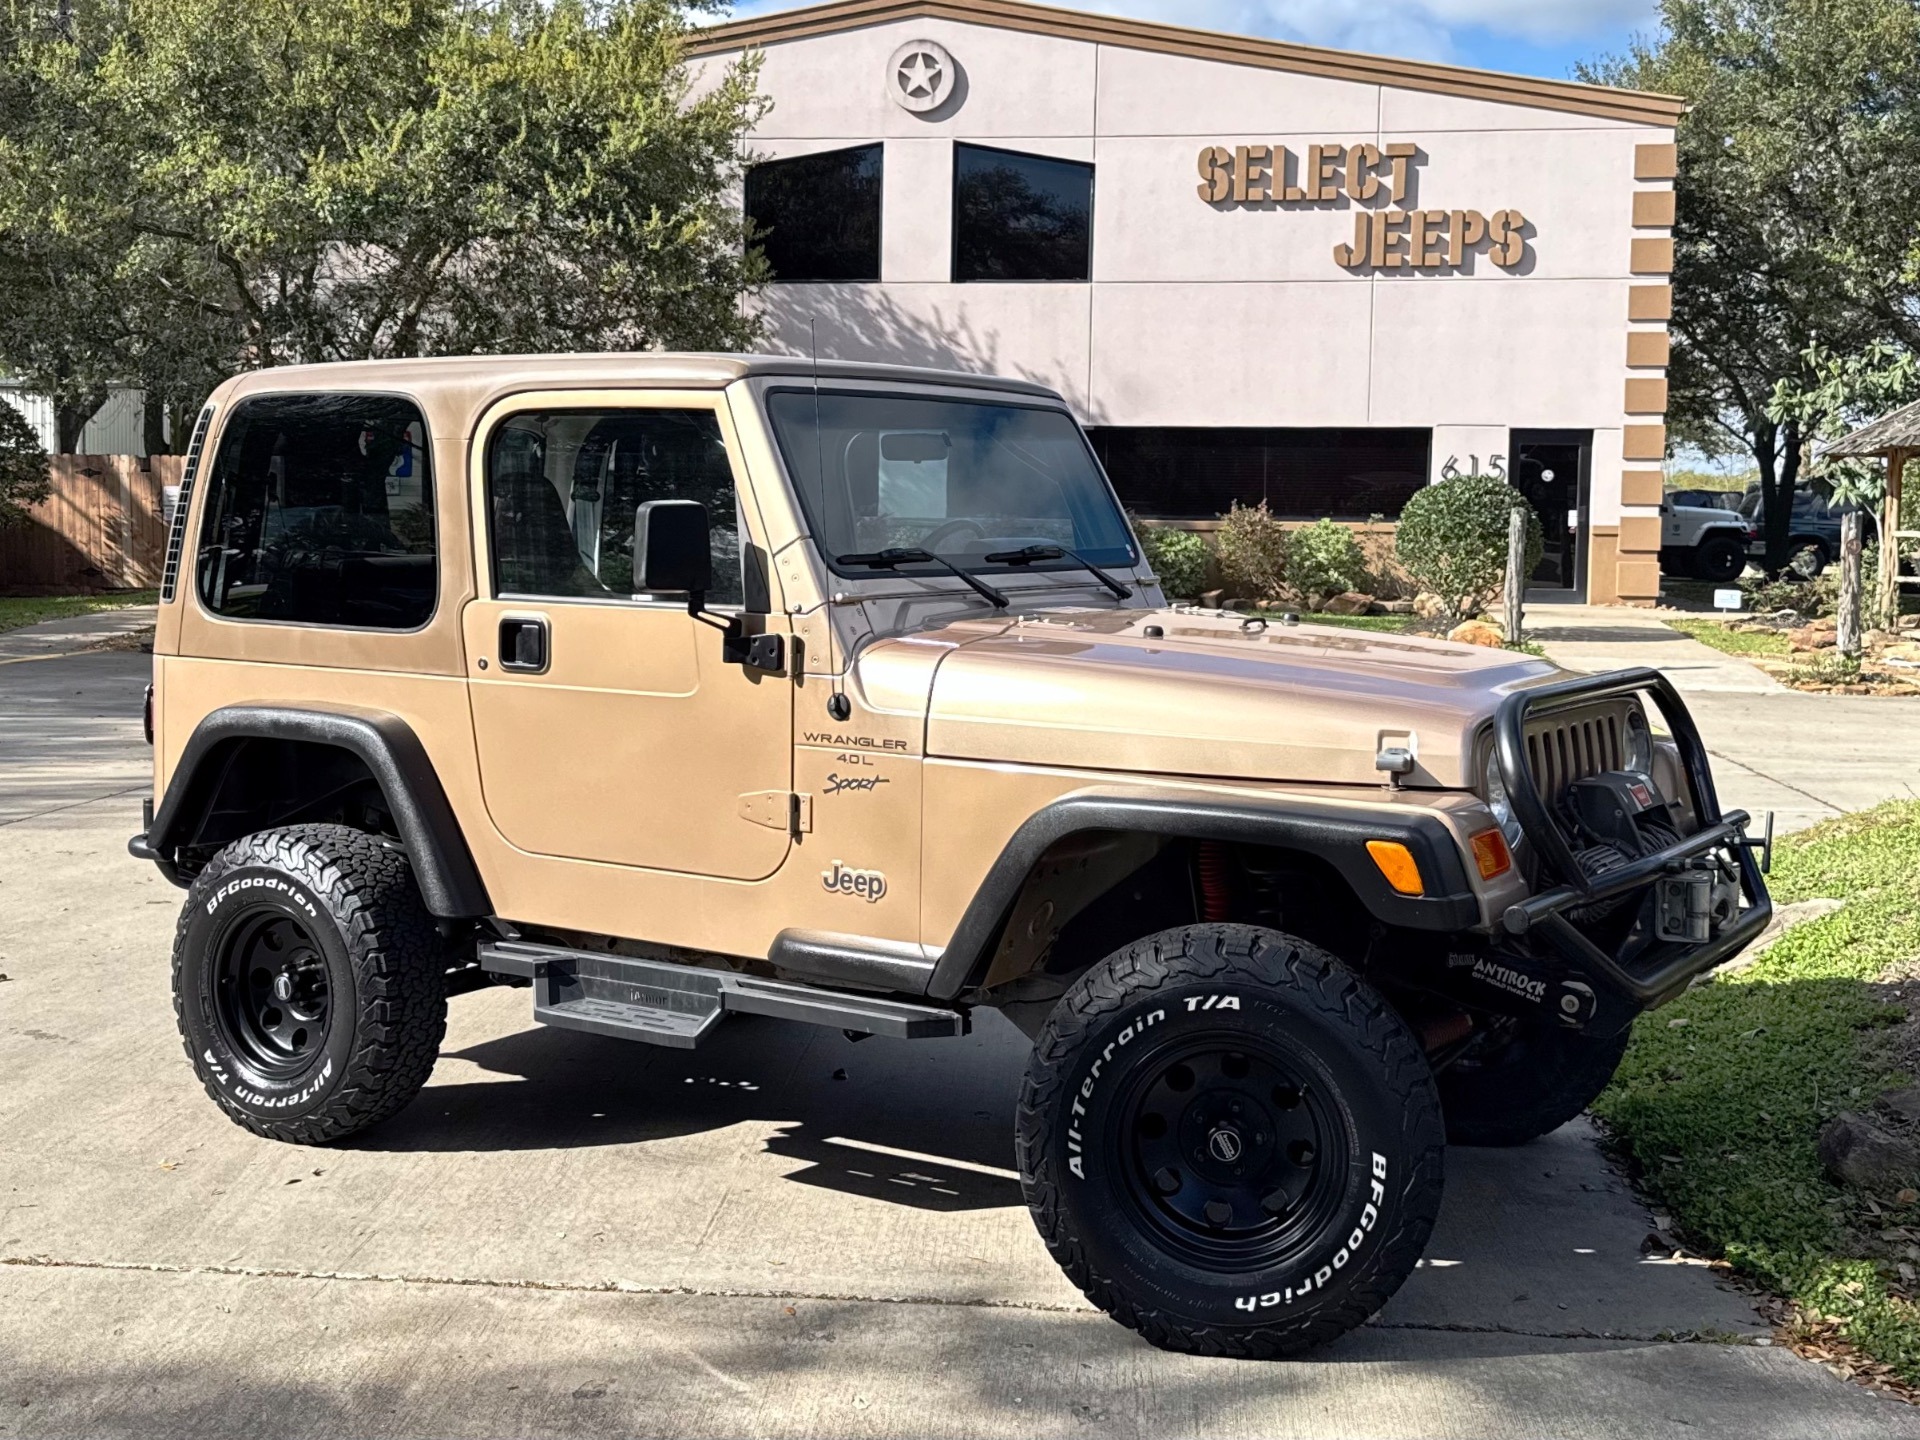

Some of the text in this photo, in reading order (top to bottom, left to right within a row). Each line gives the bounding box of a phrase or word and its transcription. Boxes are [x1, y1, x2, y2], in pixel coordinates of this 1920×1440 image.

[1197, 143, 1416, 202] SELECT
[1333, 209, 1525, 267] JEEPS
[1441, 454, 1506, 480] 615
[803, 731, 908, 751] WRANGLER
[206, 877, 317, 917] BFGoodrich
[822, 862, 886, 901] Jeep
[1473, 957, 1547, 997] ANTIROCK
[203, 1049, 332, 1108] All-Terrain T/A
[1067, 1007, 1166, 1180] All-Terrain
[1183, 994, 1241, 1012] T/A
[1234, 1151, 1388, 1313] BFGoodrich
